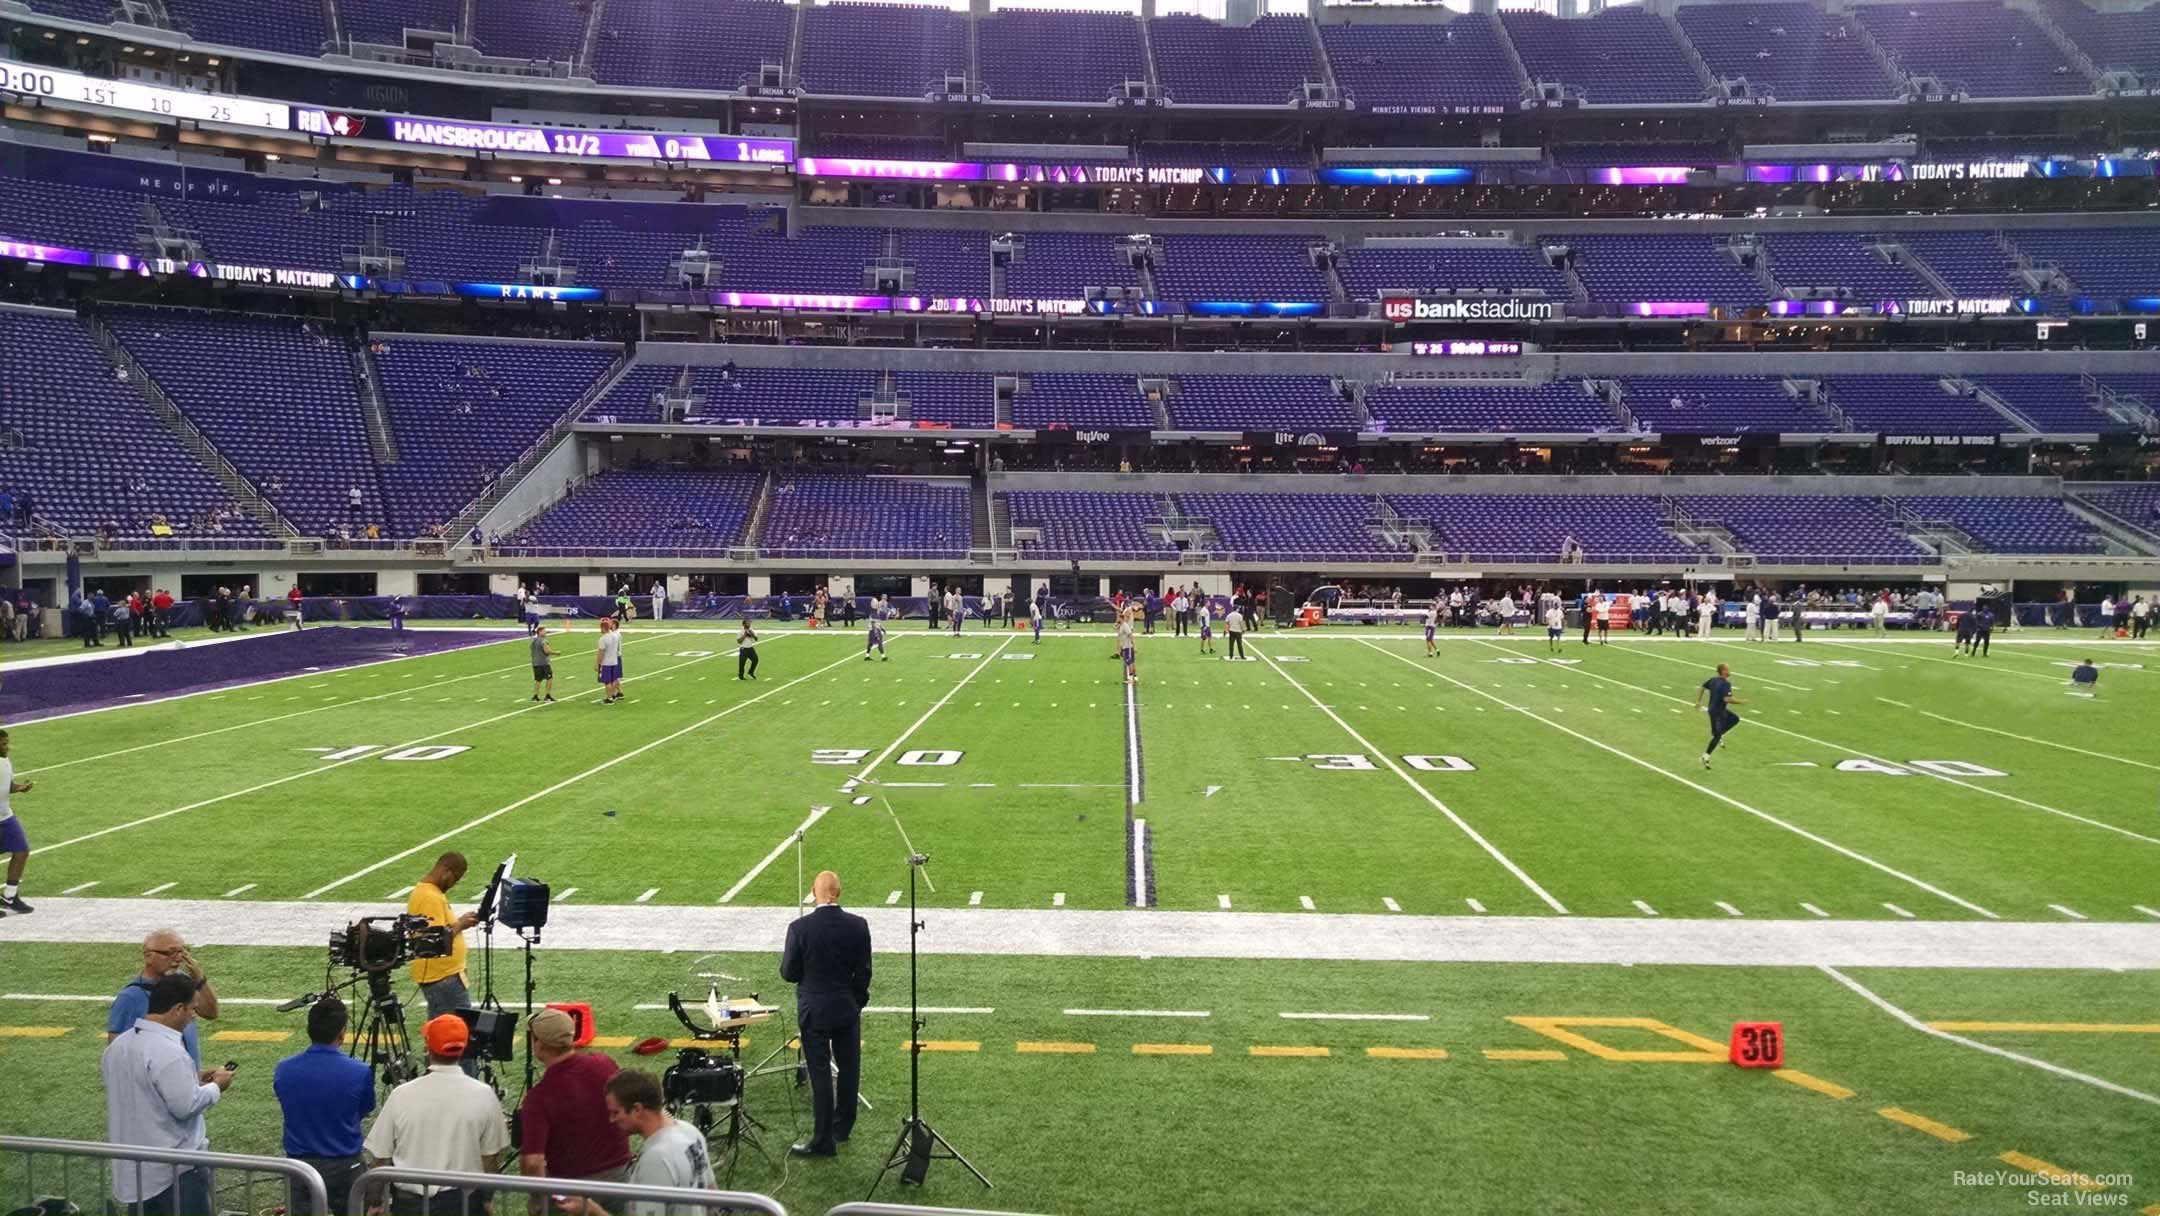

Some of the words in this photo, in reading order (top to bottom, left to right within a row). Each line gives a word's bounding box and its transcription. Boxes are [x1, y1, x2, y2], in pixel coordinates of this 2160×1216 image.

[82, 87, 117, 106] 1ST
[151, 98, 171, 113] 10
[211, 106, 231, 121] 25
[332, 116, 350, 136] 4
[394, 121, 542, 152] HANSBROUGH
[554, 135, 600, 156] 11/2
[665, 139, 680, 158] 0
[738, 143, 749, 160] 1
[1095, 167, 1143, 182] TODAY'S
[1149, 168, 1203, 183] MATCHUP
[1912, 164, 1964, 180] TODAY'S
[1969, 162, 2029, 178] MATCHUP
[217, 264, 271, 282] TODAY'S
[276, 270, 335, 288] MATCHUP
[990, 299, 1032, 313] TODAY'S
[1037, 300, 1087, 313] MATCHUP
[1908, 300, 1953, 313] TODAY'S
[1958, 299, 2011, 313] MATCHUP
[1275, 432, 1294, 445] Lite
[1700, 436, 1738, 445] verizon
[1885, 436, 1931, 445] BUFFALO
[1933, 436, 1960, 445] WILD
[1962, 436, 1995, 445] WINGS
[1741, 1027, 1777, 1062] 30
